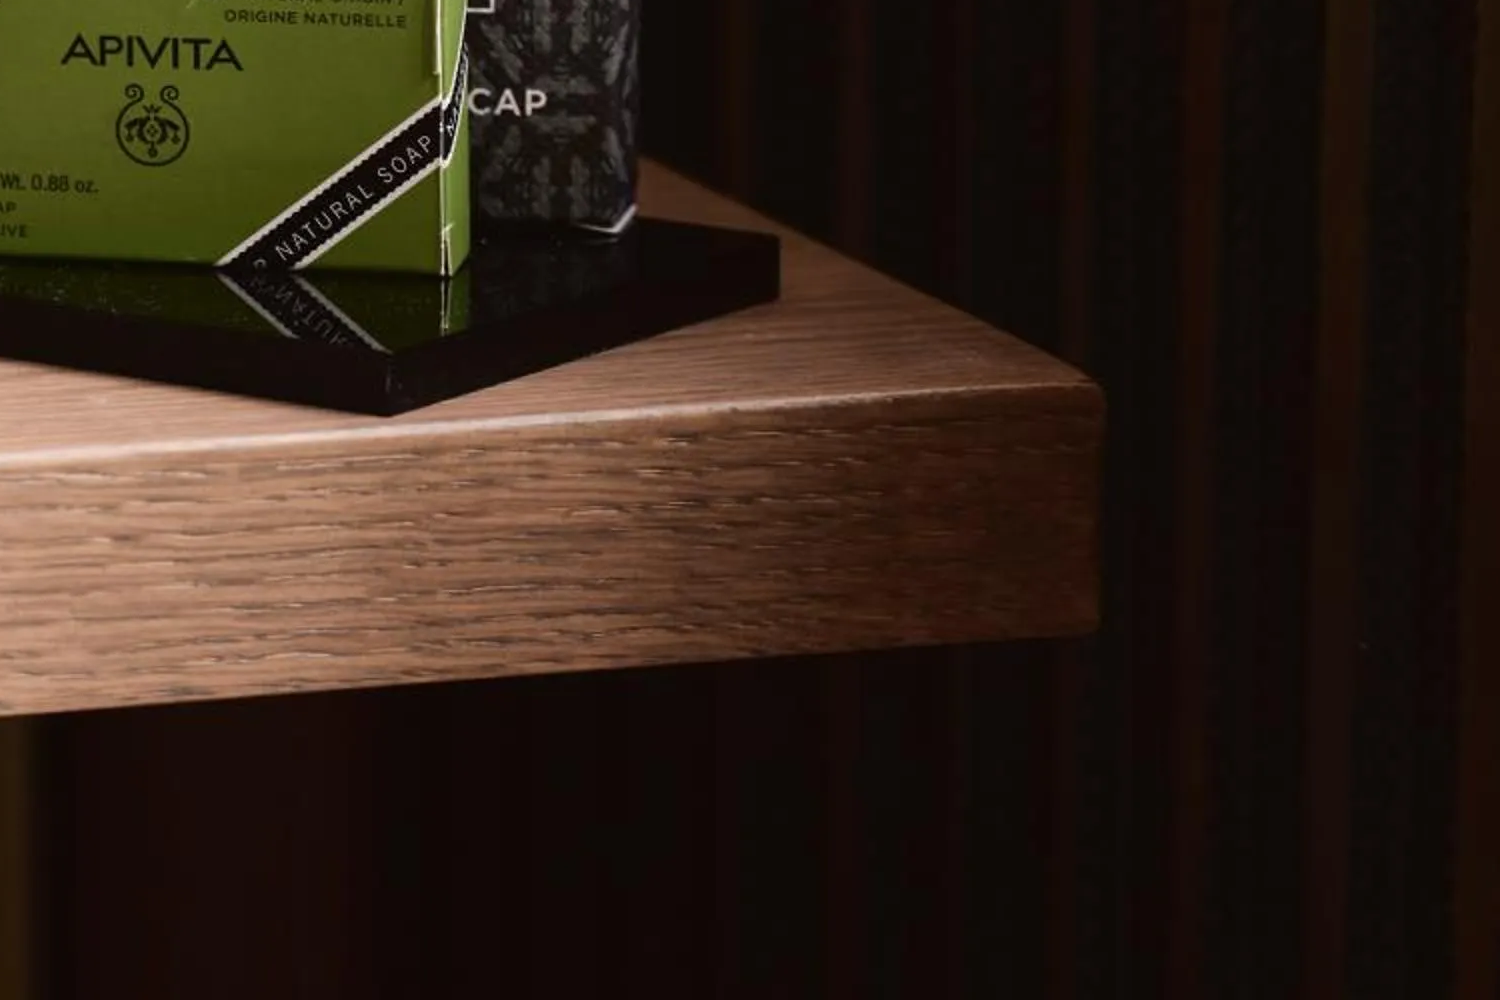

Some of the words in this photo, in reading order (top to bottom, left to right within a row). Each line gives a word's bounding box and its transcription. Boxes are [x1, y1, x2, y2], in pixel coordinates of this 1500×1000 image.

[224, 9, 299, 25] ORIGINE
[303, 12, 408, 29] NATURELLE
[60, 34, 244, 72] APIVITA
[30, 174, 70, 193] 0.88
[74, 180, 100, 194] oz.
[275, 184, 375, 261] NATURAL
[377, 135, 432, 184] SOAP
